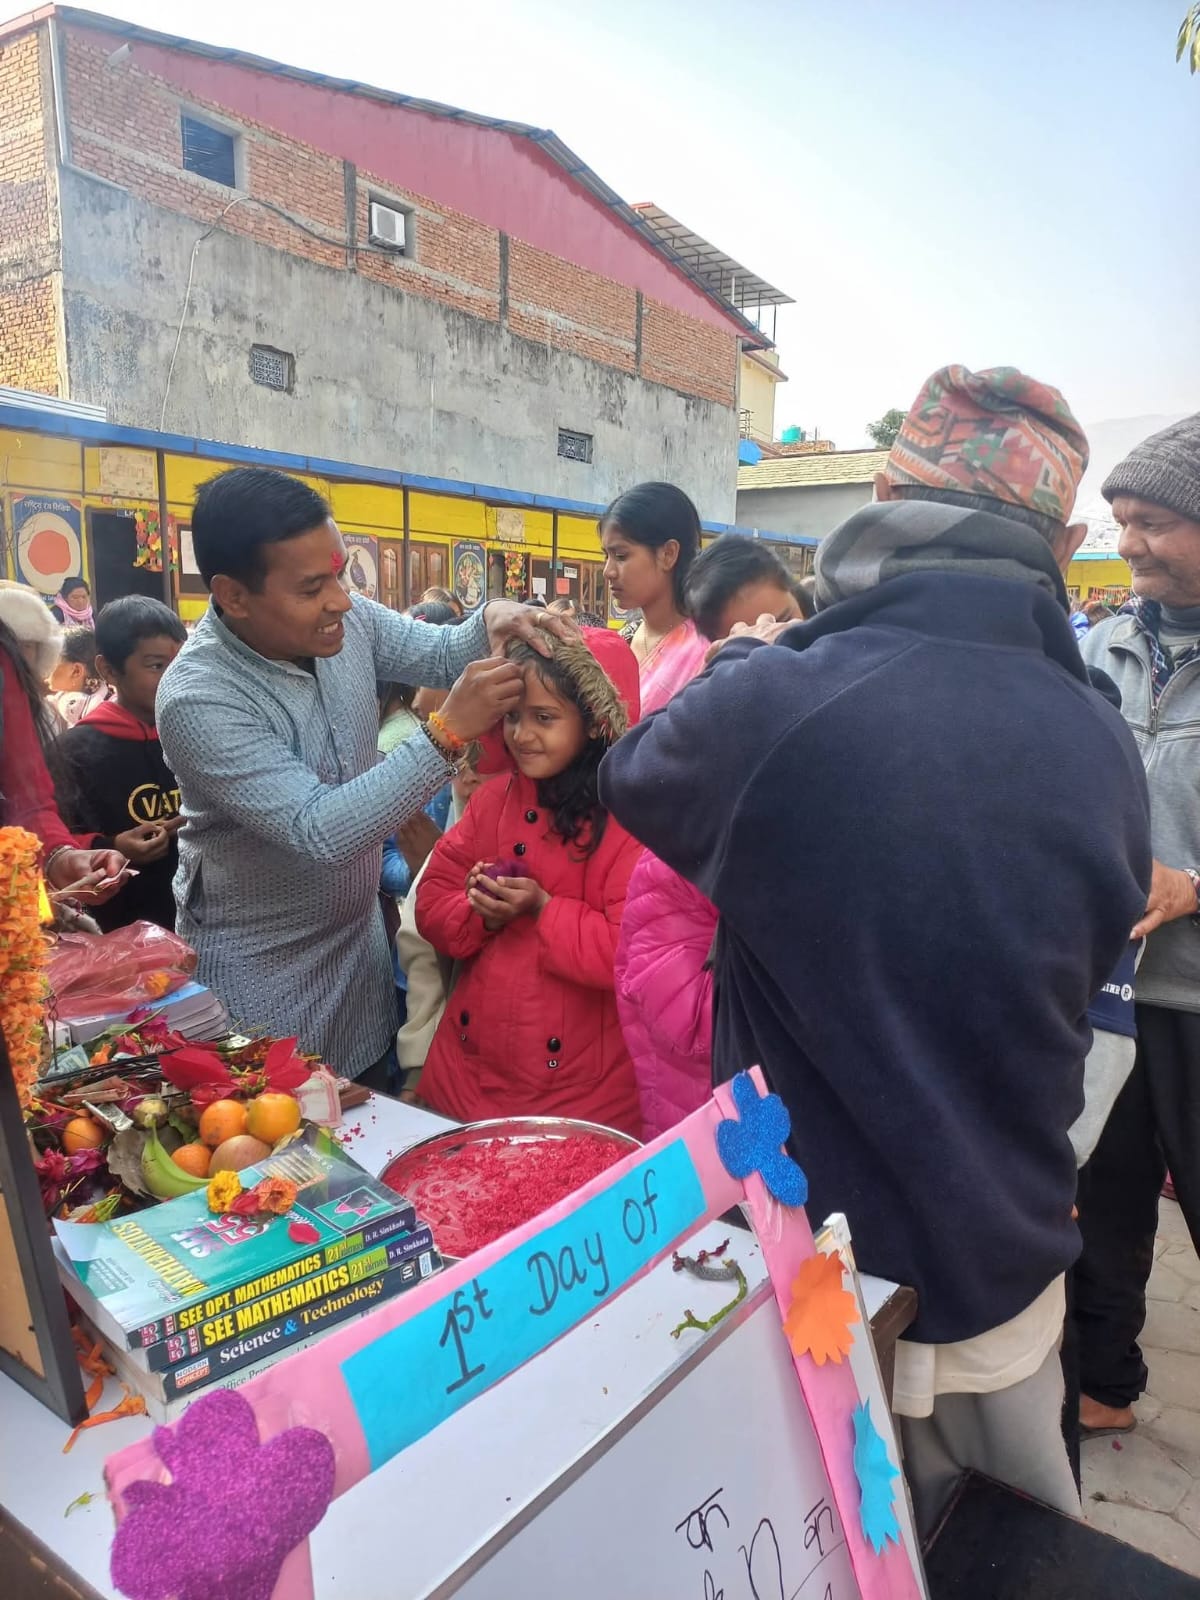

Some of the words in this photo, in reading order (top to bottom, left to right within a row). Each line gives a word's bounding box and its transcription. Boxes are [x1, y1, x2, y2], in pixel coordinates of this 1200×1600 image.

[112, 1221, 208, 1297] MATHEMATICS
[179, 1305, 204, 1329] SEE
[205, 1294, 234, 1318] OPT.
[235, 1253, 321, 1305] MATHEMATICS
[188, 1326, 200, 1357] SETS
[202, 1318, 235, 1347] SEE
[235, 1264, 350, 1332] MATHEMATICS
[389, 1250, 396, 1259] D.
[396, 1246, 404, 1255] R.
[219, 1326, 281, 1364] Science
[283, 1319, 299, 1336] &
[300, 1278, 385, 1326] Technology
[437, 1279, 493, 1395] 1st
[526, 1231, 609, 1316] Day
[175, 1359, 208, 1379] MODERN
